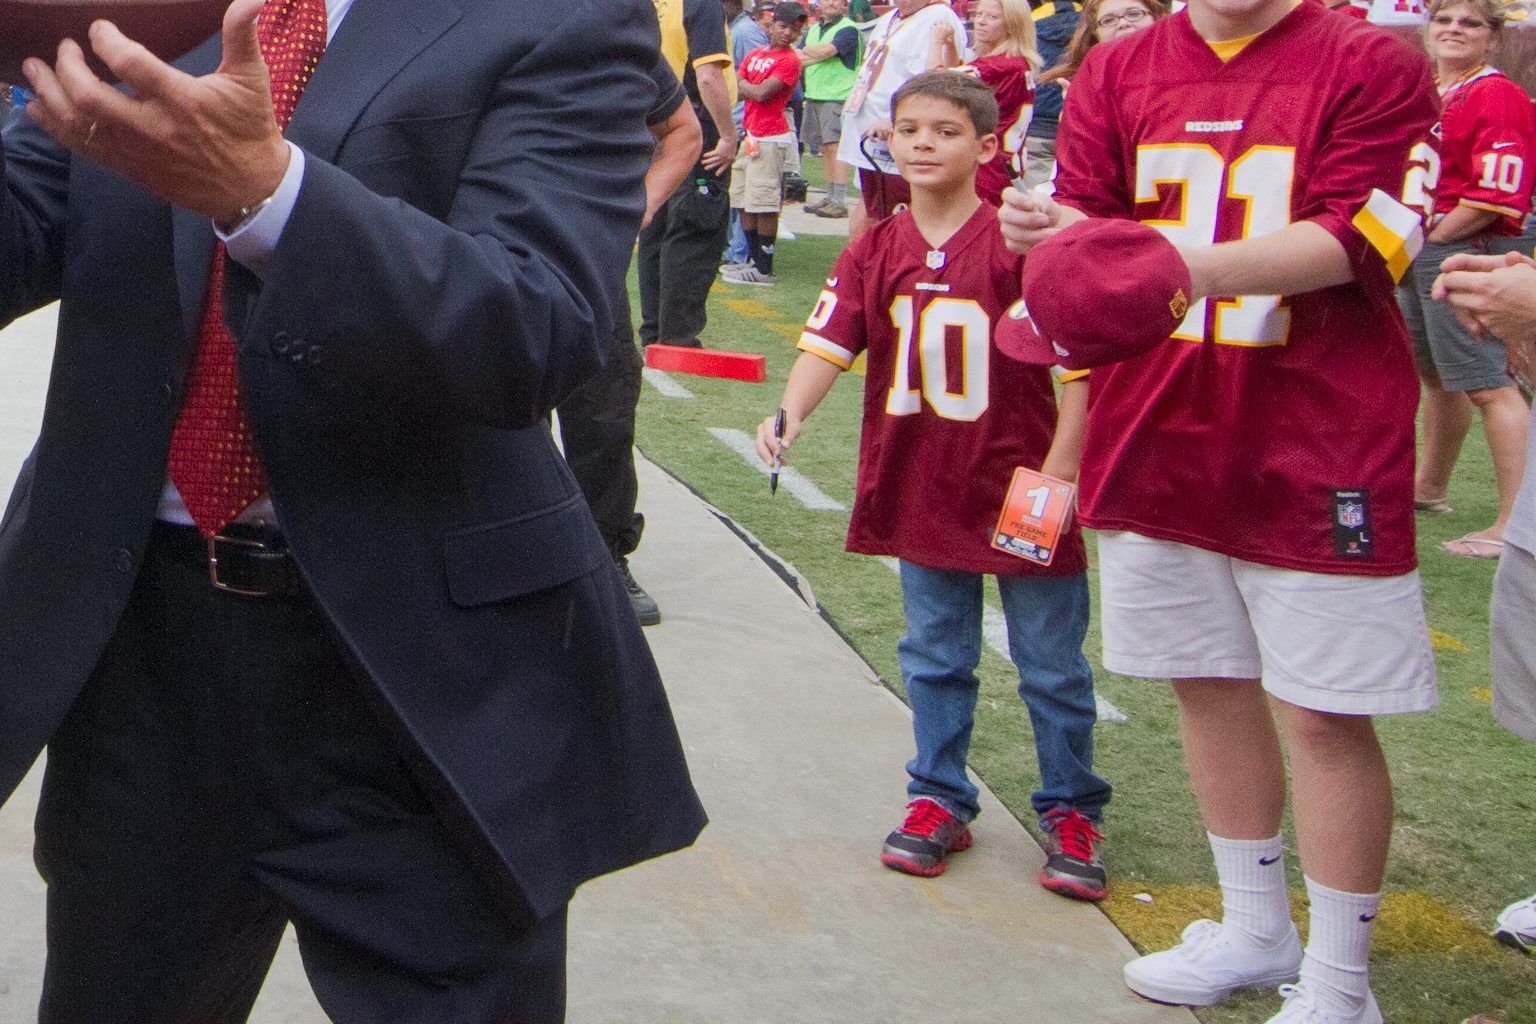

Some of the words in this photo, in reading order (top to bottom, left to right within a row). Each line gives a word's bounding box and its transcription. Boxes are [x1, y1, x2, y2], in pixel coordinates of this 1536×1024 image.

[1478, 152, 1524, 194] 10
[885, 294, 991, 422] 10
[1026, 485, 1051, 518] 1
[1359, 531, 1370, 543] L
